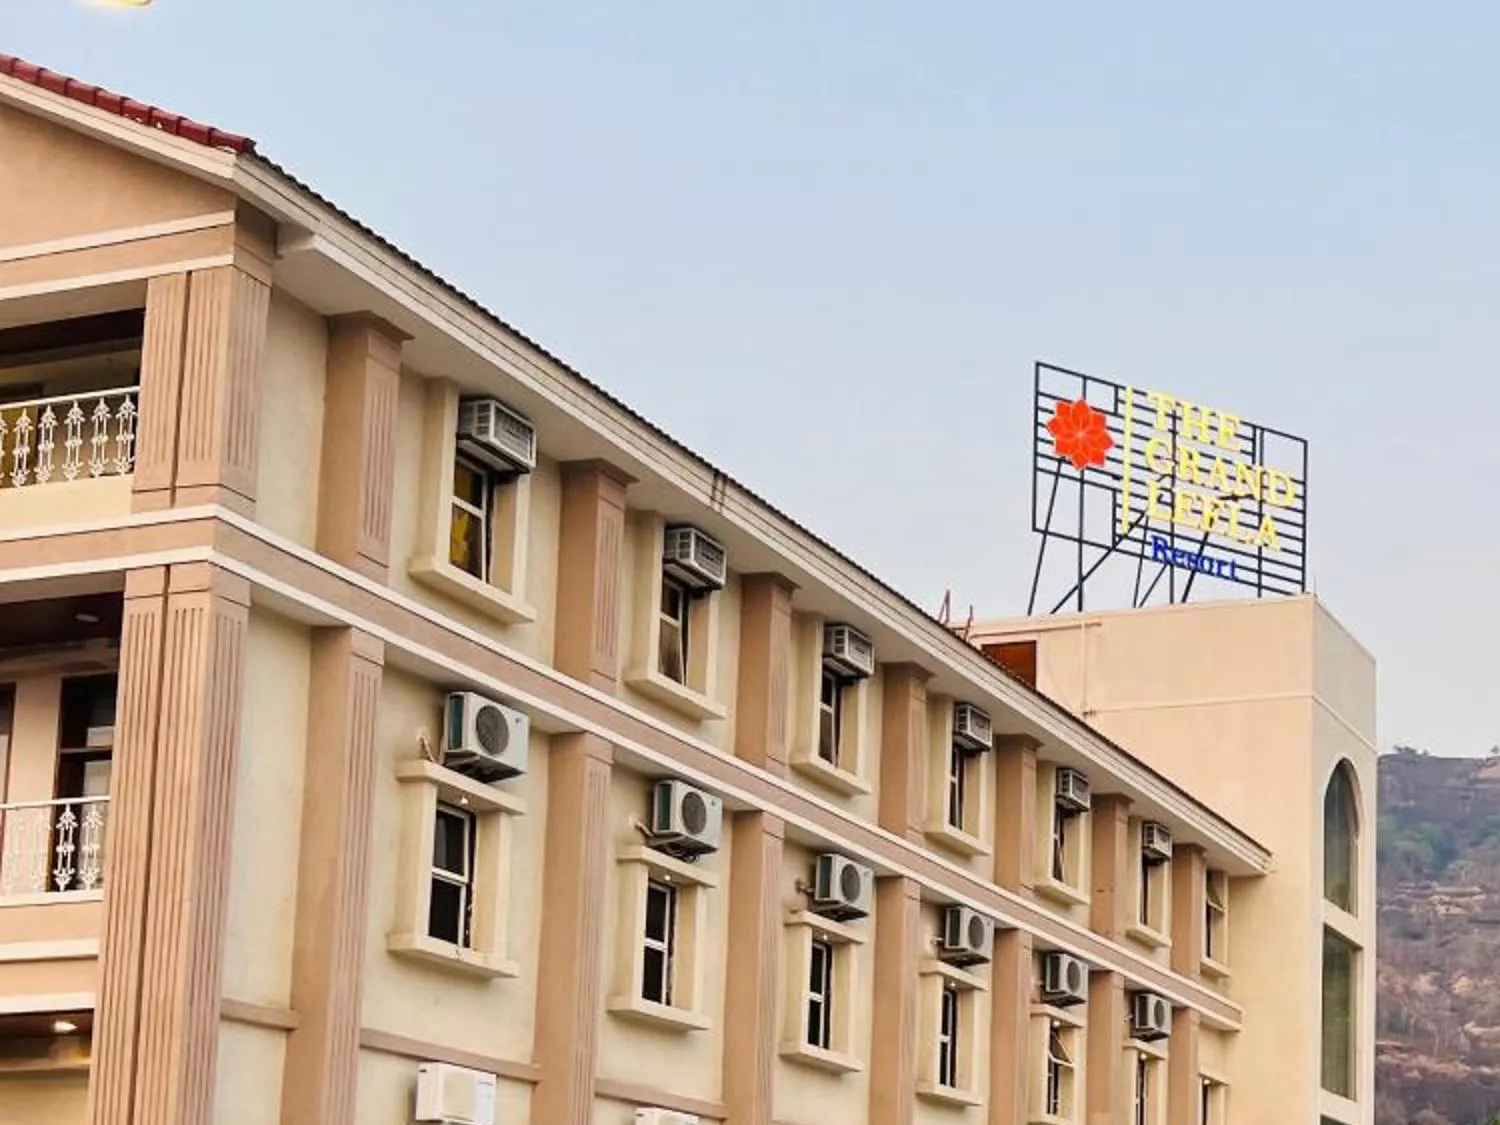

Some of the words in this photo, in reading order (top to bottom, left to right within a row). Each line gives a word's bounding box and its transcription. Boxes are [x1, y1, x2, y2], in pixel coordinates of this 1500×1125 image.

[1148, 389, 1241, 452] THE
[1145, 437, 1297, 508] GRAND
[1148, 479, 1282, 552] LEELA
[1151, 534, 1239, 582] Resort
